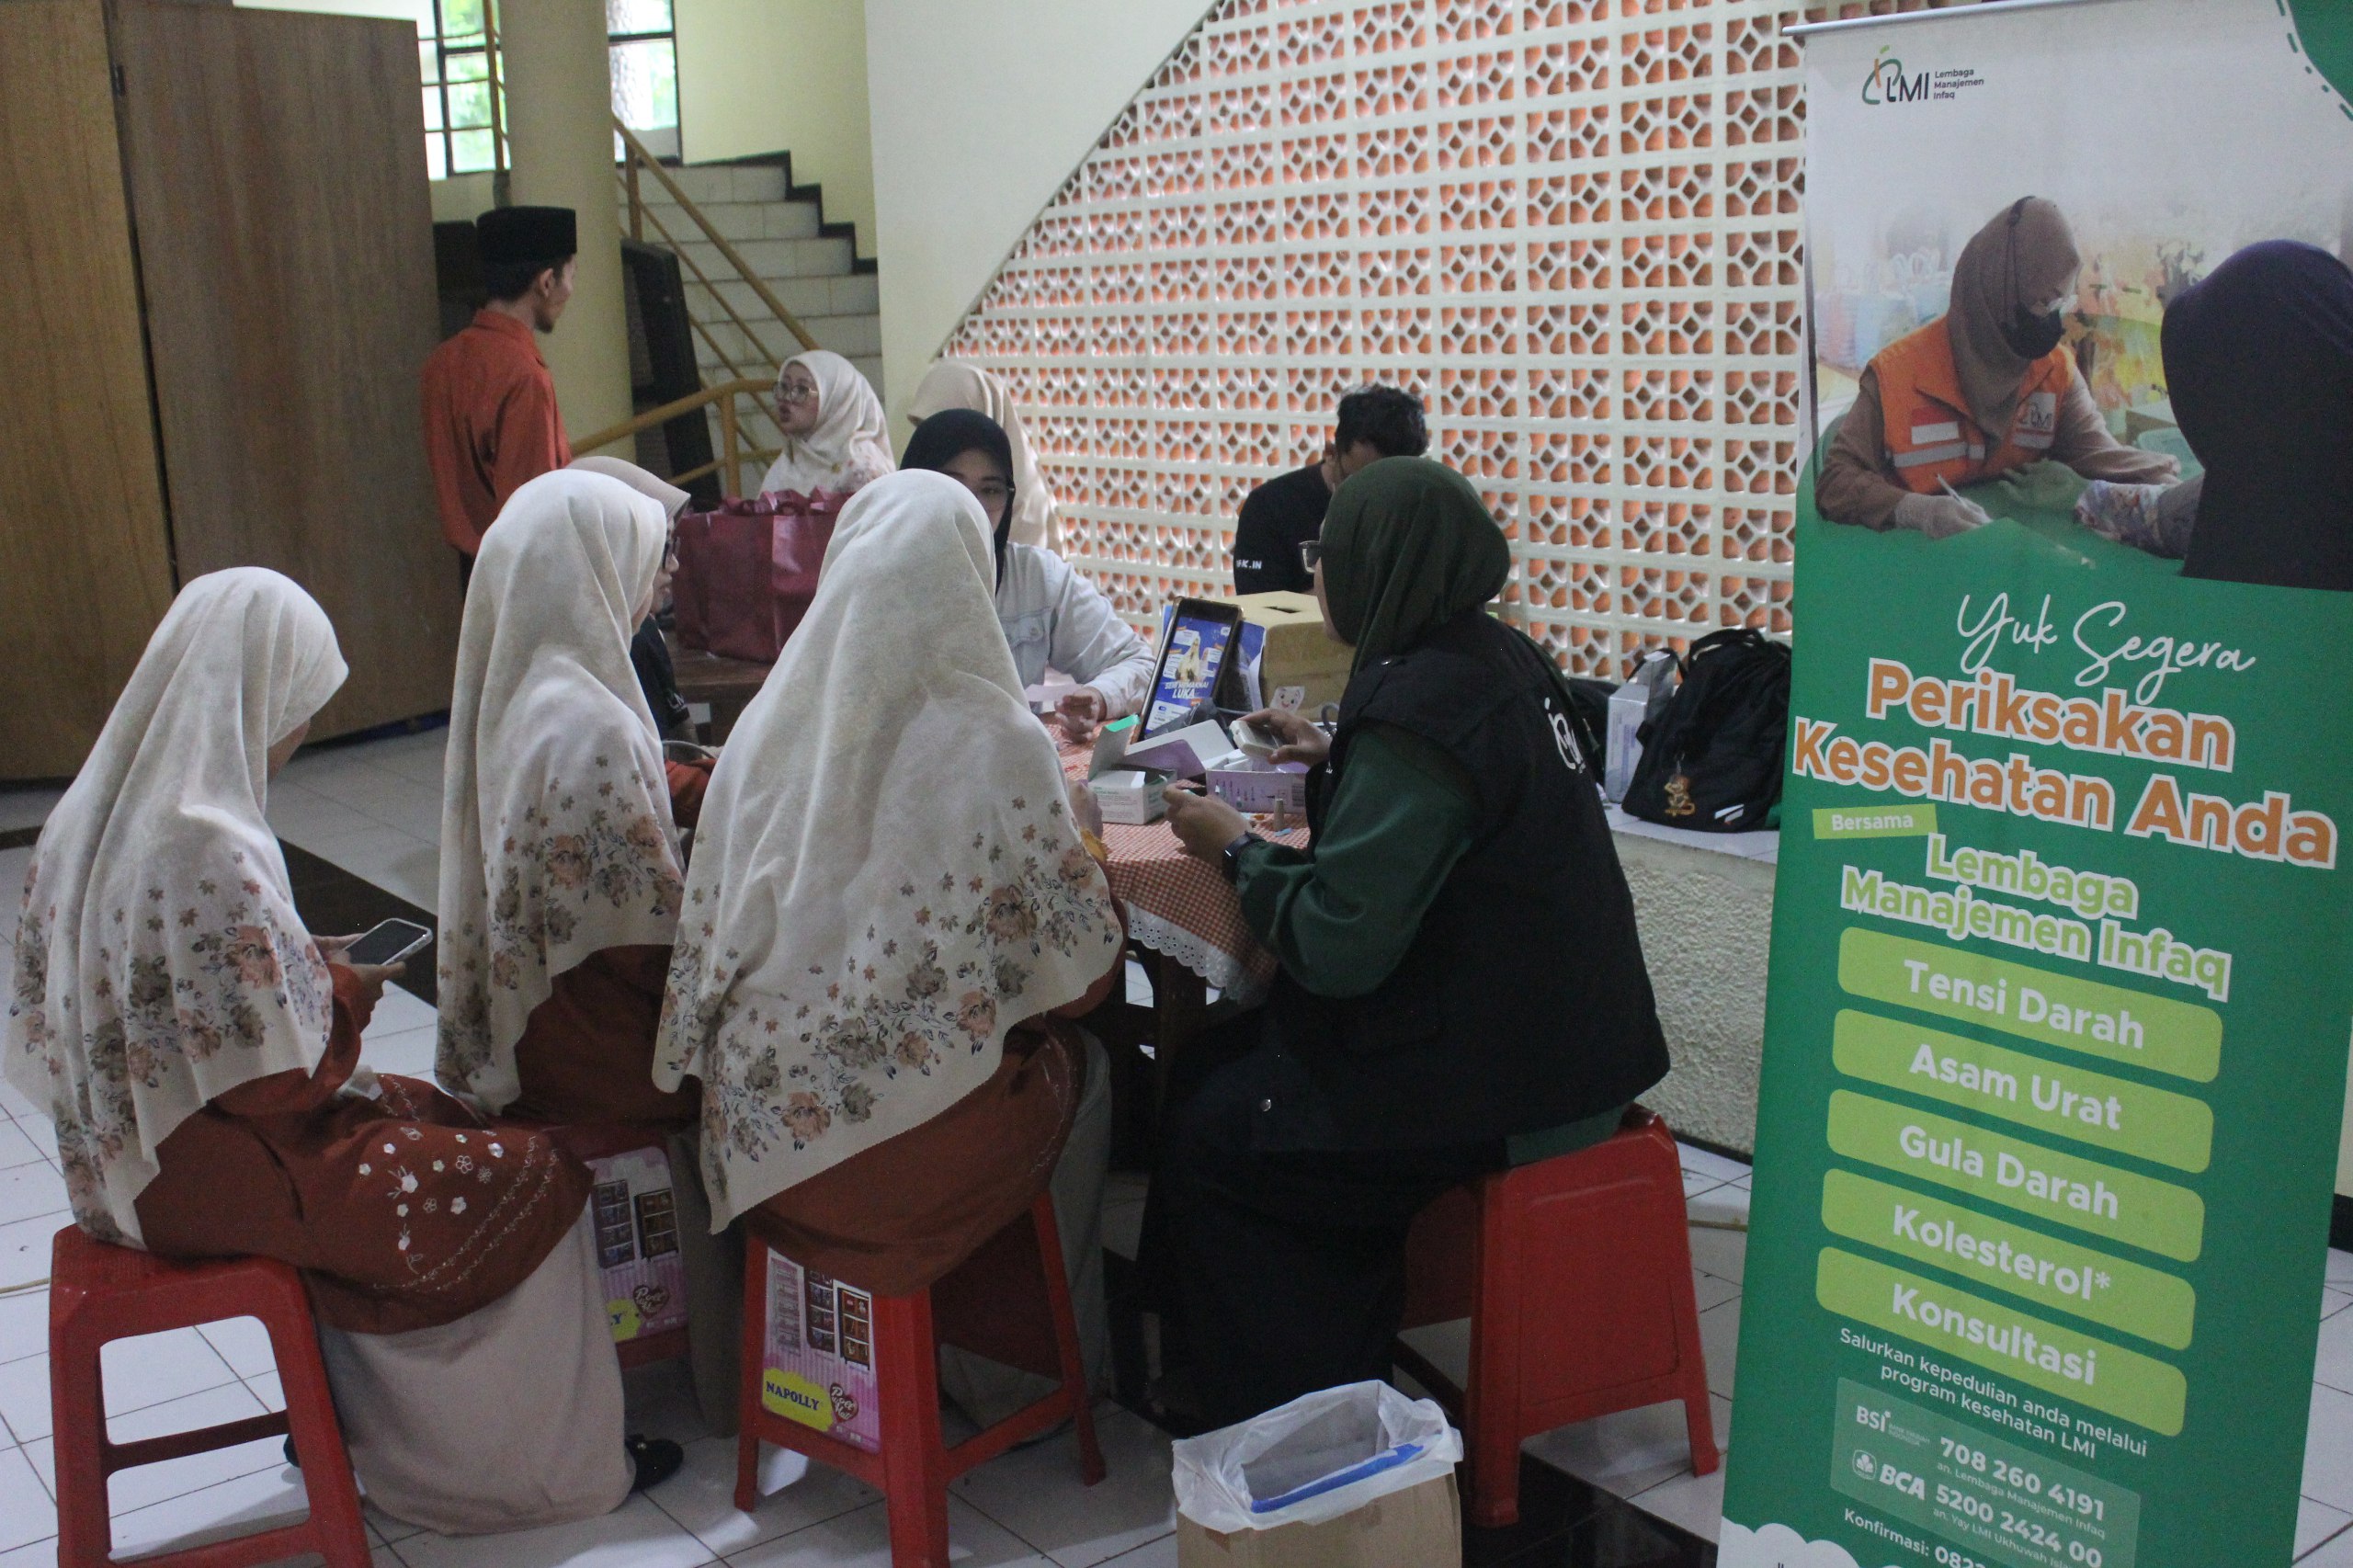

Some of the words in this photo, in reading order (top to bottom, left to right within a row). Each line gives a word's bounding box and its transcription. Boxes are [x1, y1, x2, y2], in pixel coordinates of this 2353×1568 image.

[1933, 78, 1984, 89] Manajemen
[1933, 91, 1955, 100] Infaq
[1934, 68, 1974, 79] Lembaga
[1957, 592, 2058, 675] Yuk
[2073, 601, 2256, 706] Segera
[1172, 688, 1196, 699] LUKA
[1866, 657, 2235, 773] Periksakan
[1792, 716, 2115, 833] Kesehatan
[2123, 773, 2337, 870] Anda
[1831, 812, 1915, 832] Bersama
[1926, 832, 2139, 920] Lembaga
[1840, 864, 2092, 962] Manajemen
[2097, 918, 2232, 1003] Infaq
[1904, 959, 2006, 1015] Tensi
[2018, 988, 2145, 1049] Darah
[1909, 1043, 2017, 1102] Asam
[2030, 1074, 2122, 1131] Urat
[1899, 1125, 1984, 1178] Gula
[1996, 1152, 2119, 1220] Darah
[1893, 1283, 2097, 1385] Konsultasi
[766, 1381, 820, 1411] NAPOLLY
[1840, 1327, 1915, 1368] Salurkan
[1920, 1356, 2018, 1408] kepedulian
[2023, 1399, 2070, 1427] anda
[2075, 1417, 2148, 1457] melalui
[1881, 1365, 1956, 1404] program
[1961, 1392, 2055, 1443] kesehatan
[2061, 1433, 2096, 1460] LMI
[1879, 1463, 1926, 1500] BCA
[1940, 1437, 1986, 1471] 708
[1993, 1460, 2041, 1494] 260
[2048, 1483, 2104, 1521] 4191
[1955, 1467, 2005, 1496] Lembaga
[2006, 1489, 2073, 1525] Manajemen
[2076, 1518, 2106, 1540] Infaq
[1844, 1507, 1929, 1556] Konfirmasi:
[1936, 1483, 1994, 1523] 5200
[2000, 1511, 2063, 1552] 2424
[2069, 1540, 2102, 1568] 00
[1972, 1525, 1992, 1539] LMI
[1994, 1534, 2048, 1563] Ukhuwah
